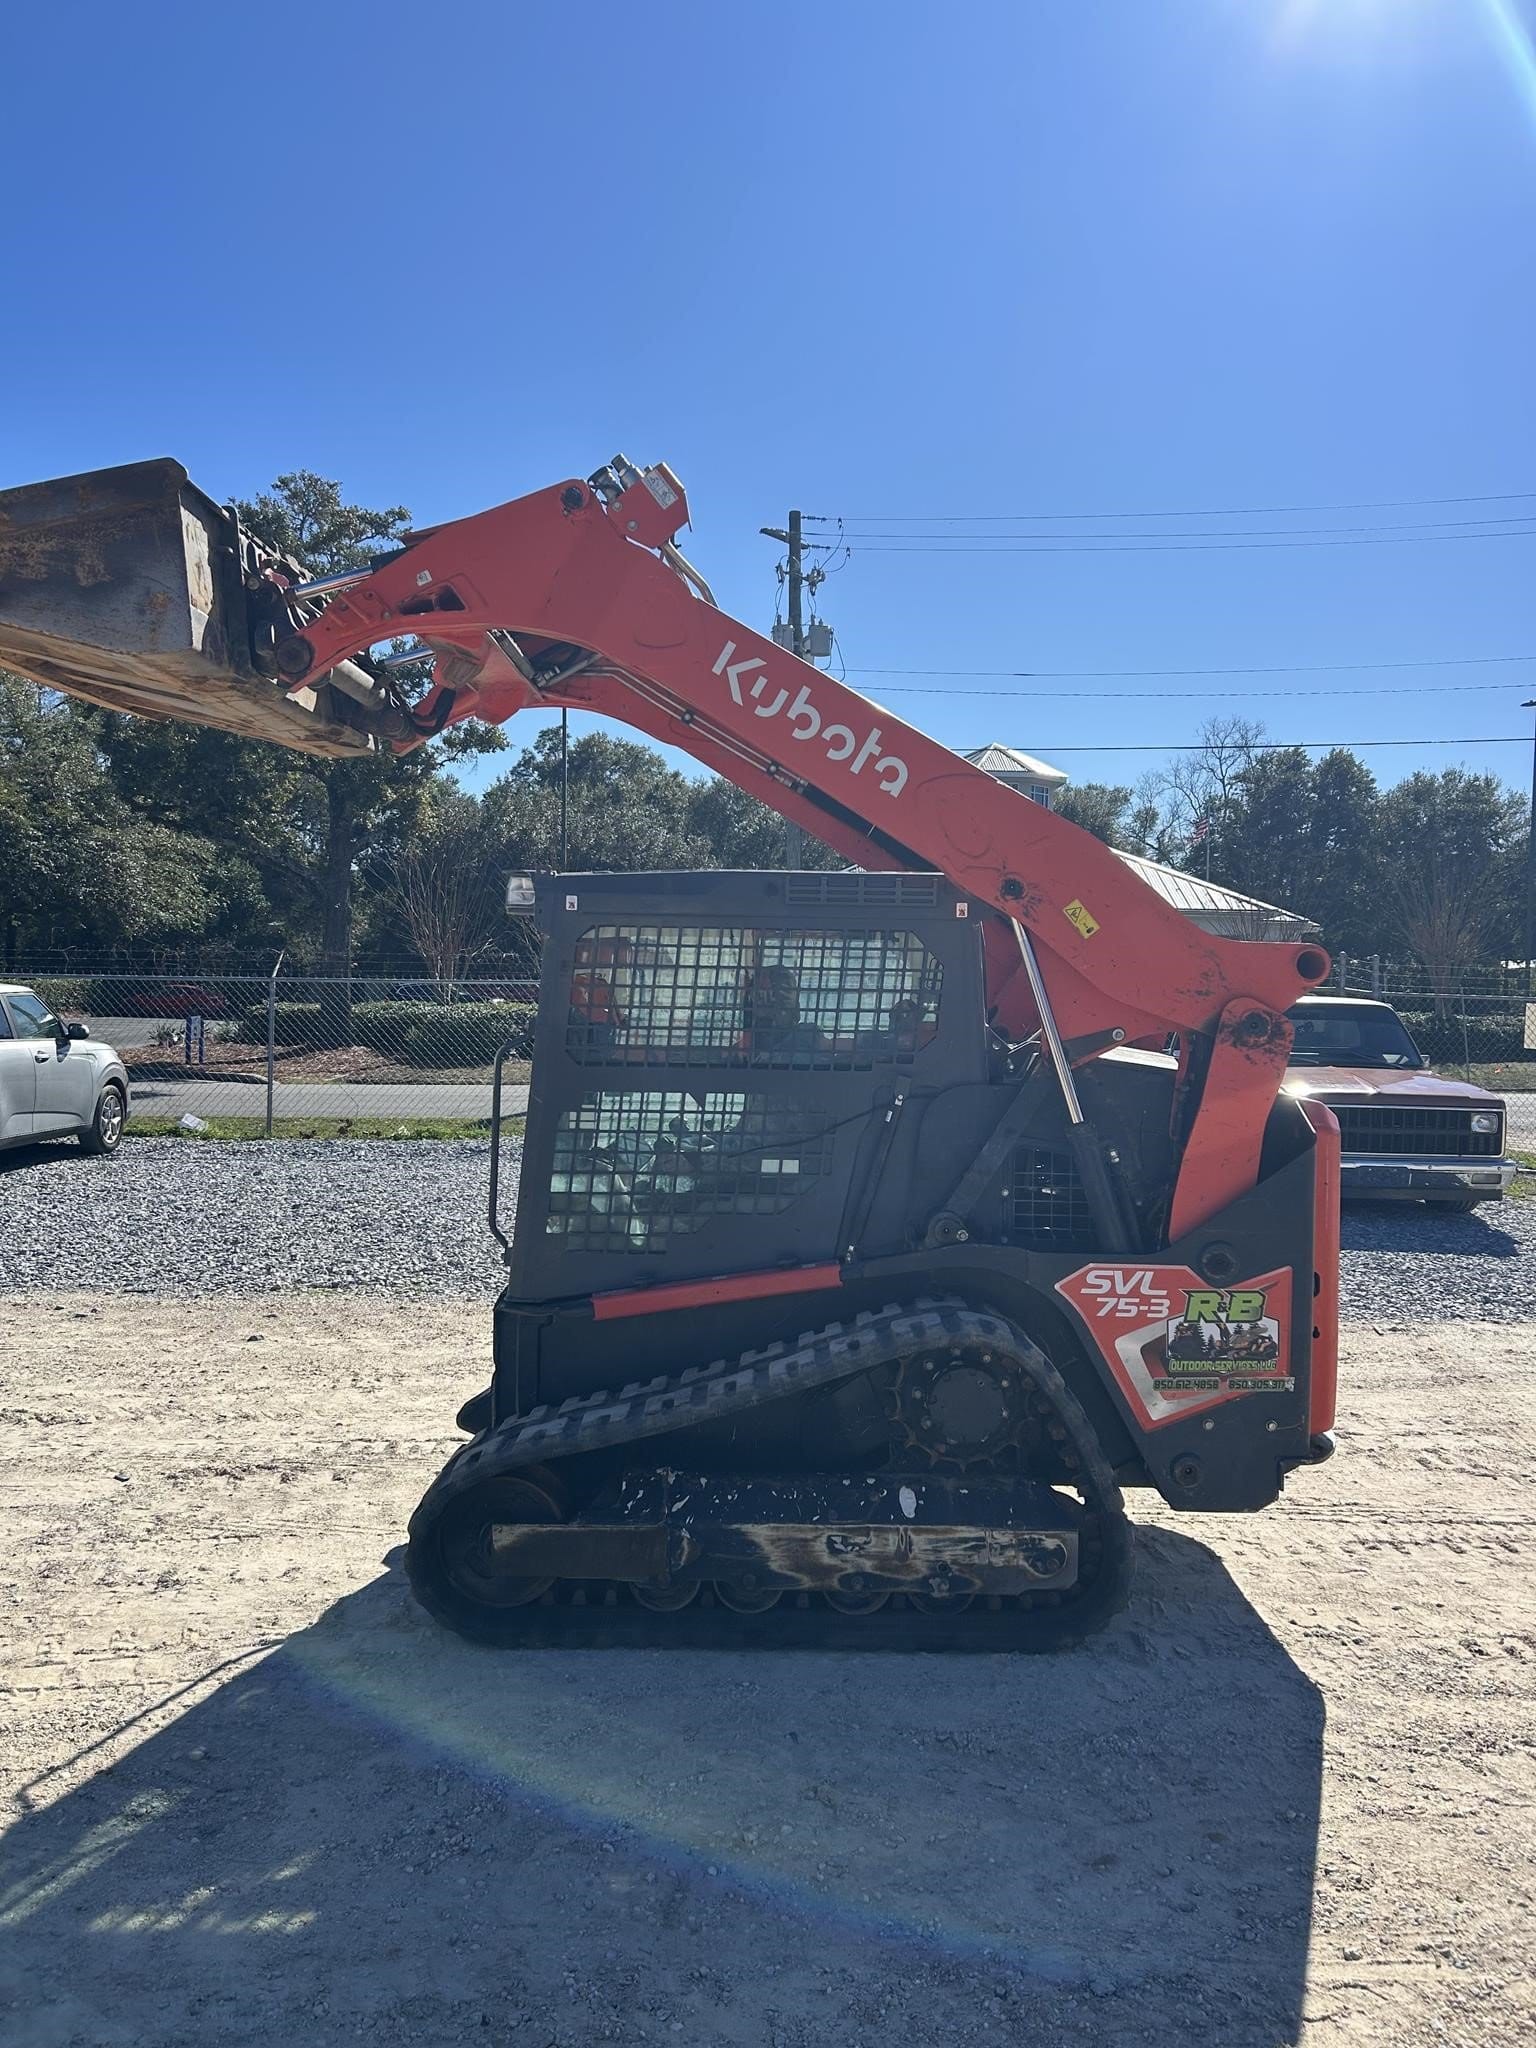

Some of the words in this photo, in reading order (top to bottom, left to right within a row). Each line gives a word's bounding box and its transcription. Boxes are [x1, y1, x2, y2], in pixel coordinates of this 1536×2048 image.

[711, 640, 908, 798] Kubota
[1080, 1269, 1168, 1296] SVL
[1096, 1298, 1170, 1318] 75-3
[1183, 1290, 1265, 1323] R&B
[1170, 1360, 1213, 1371] OUTDOOR
